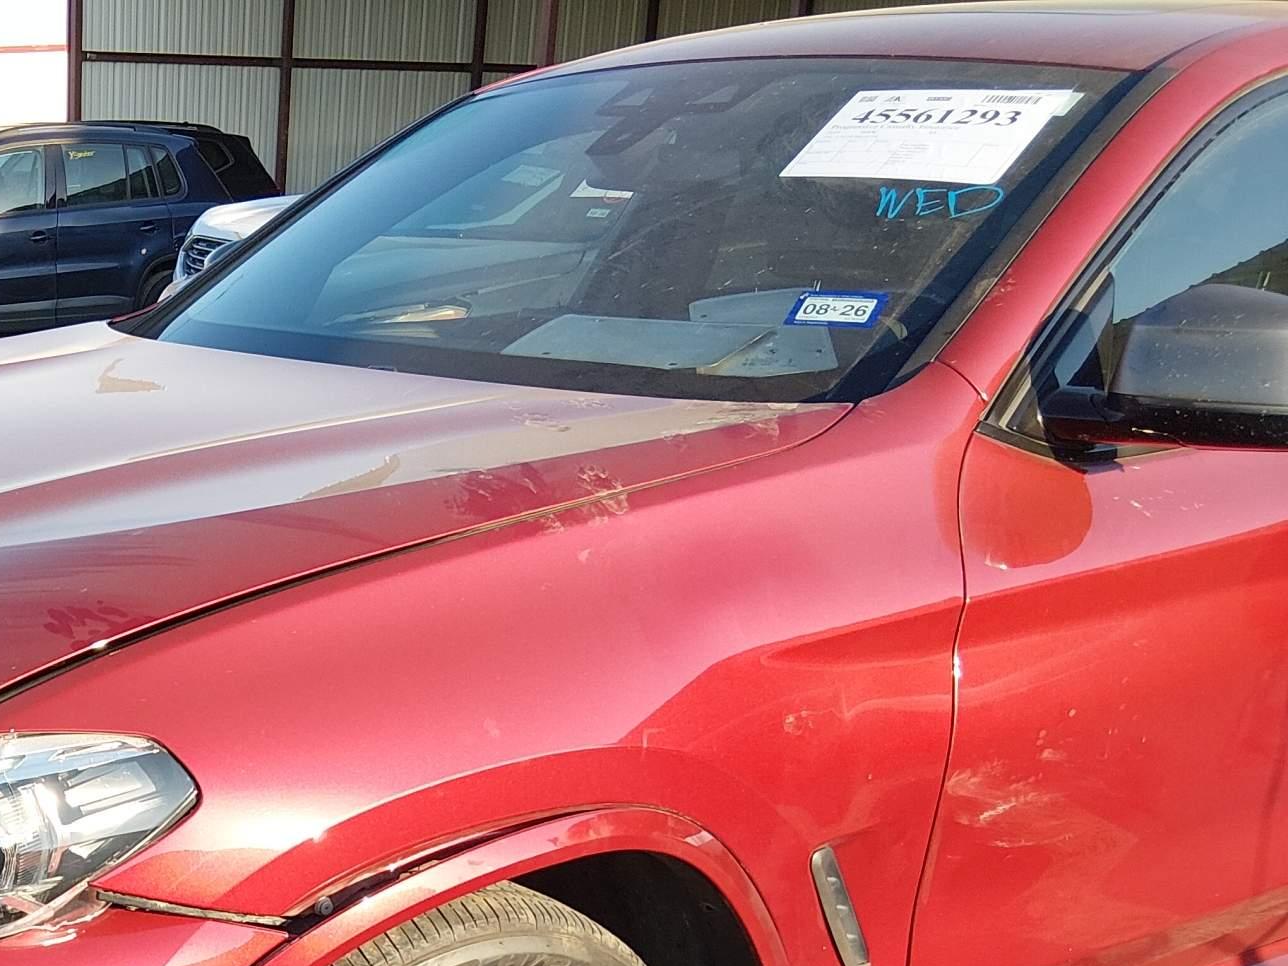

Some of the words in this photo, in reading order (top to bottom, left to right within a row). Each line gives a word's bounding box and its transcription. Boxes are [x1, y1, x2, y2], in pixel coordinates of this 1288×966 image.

[851, 108, 1023, 127] 45561293
[876, 185, 1005, 220] WED
[802, 303, 831, 315] 08
[839, 304, 869, 317] 26
